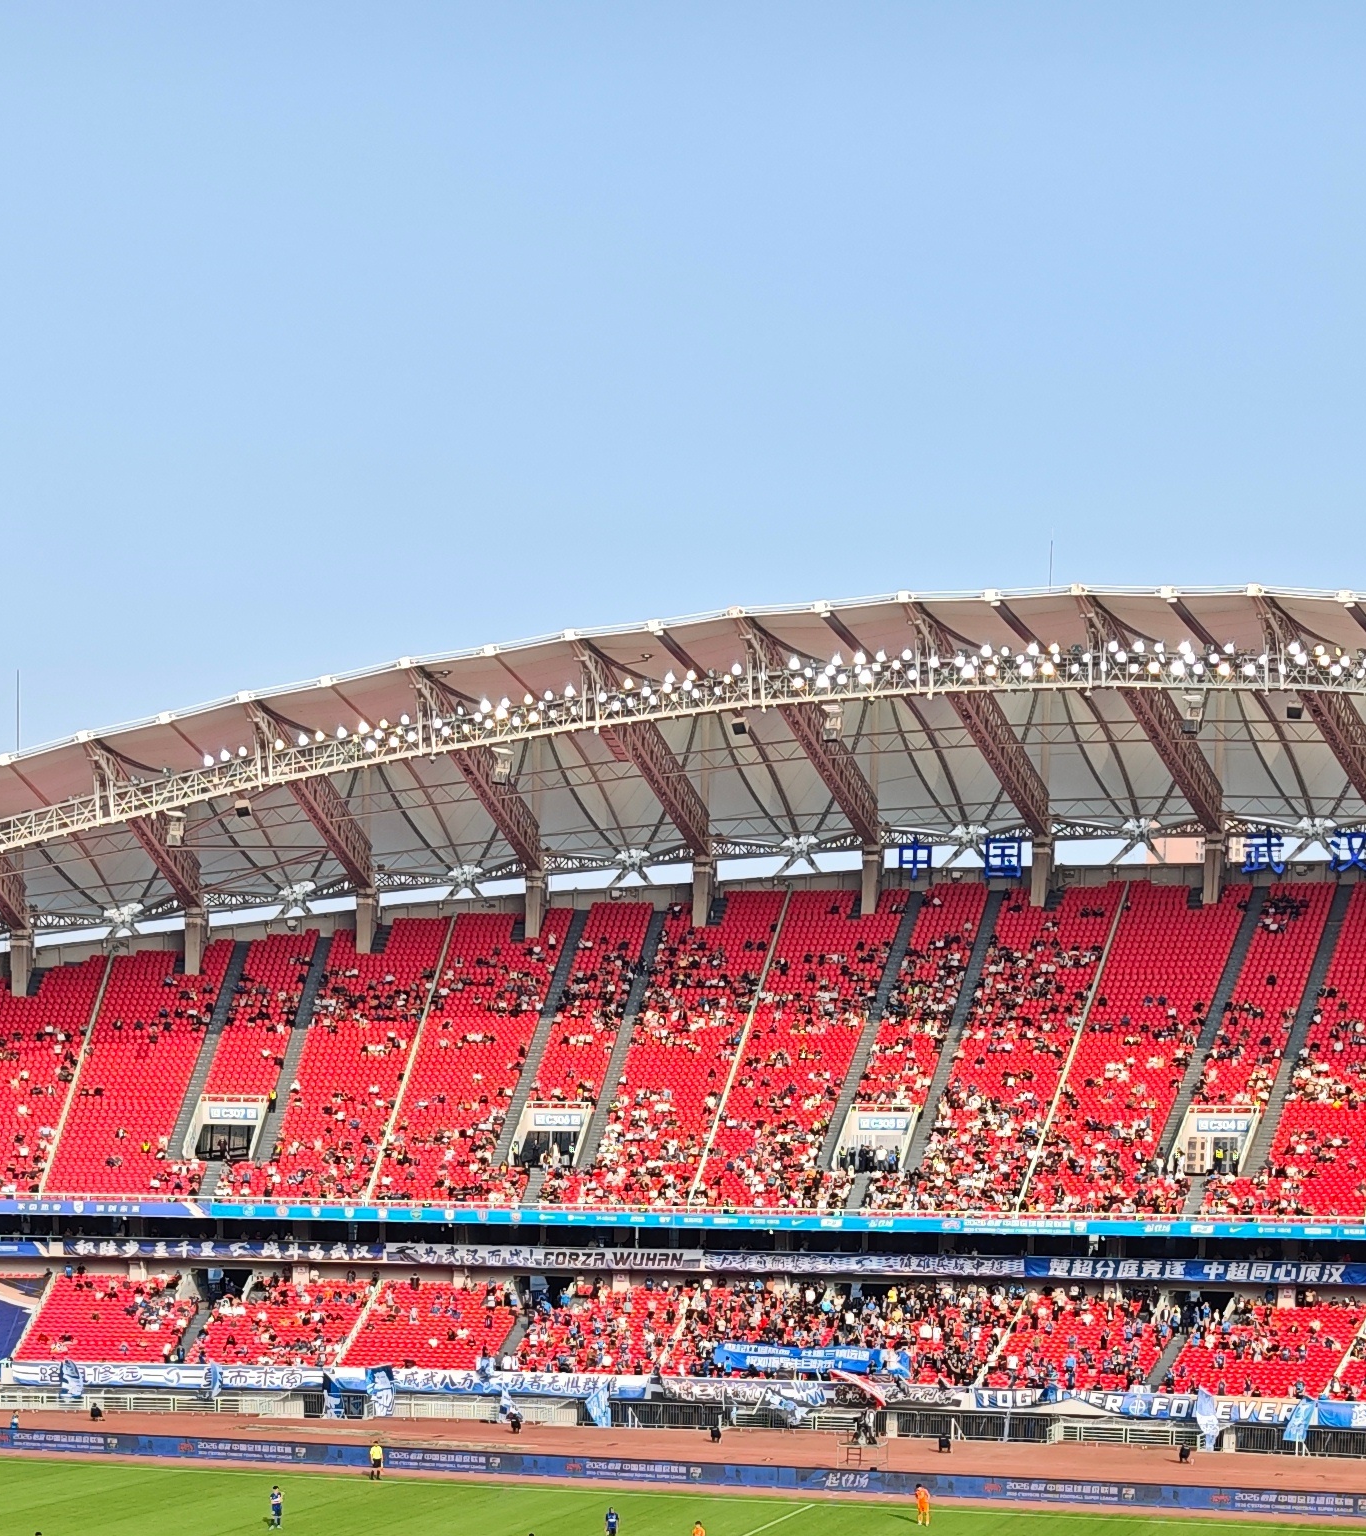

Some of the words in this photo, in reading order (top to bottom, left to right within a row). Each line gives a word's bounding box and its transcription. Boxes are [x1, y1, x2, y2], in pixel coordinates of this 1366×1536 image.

[153, 1240, 216, 1258] 至千里
[261, 1241, 373, 1261] 战斗为武汉
[543, 1252, 605, 1267] FORZA
[612, 1252, 684, 1267] WUHAN
[1048, 1259, 1186, 1278] 楚超分庭竞逐
[1203, 1262, 1346, 1283] 中超同心顶汉
[40, 1366, 142, 1383] 路修远
[1151, 1397, 1297, 1421] FOEVER
[1235, 1492, 1260, 1502] 2026
